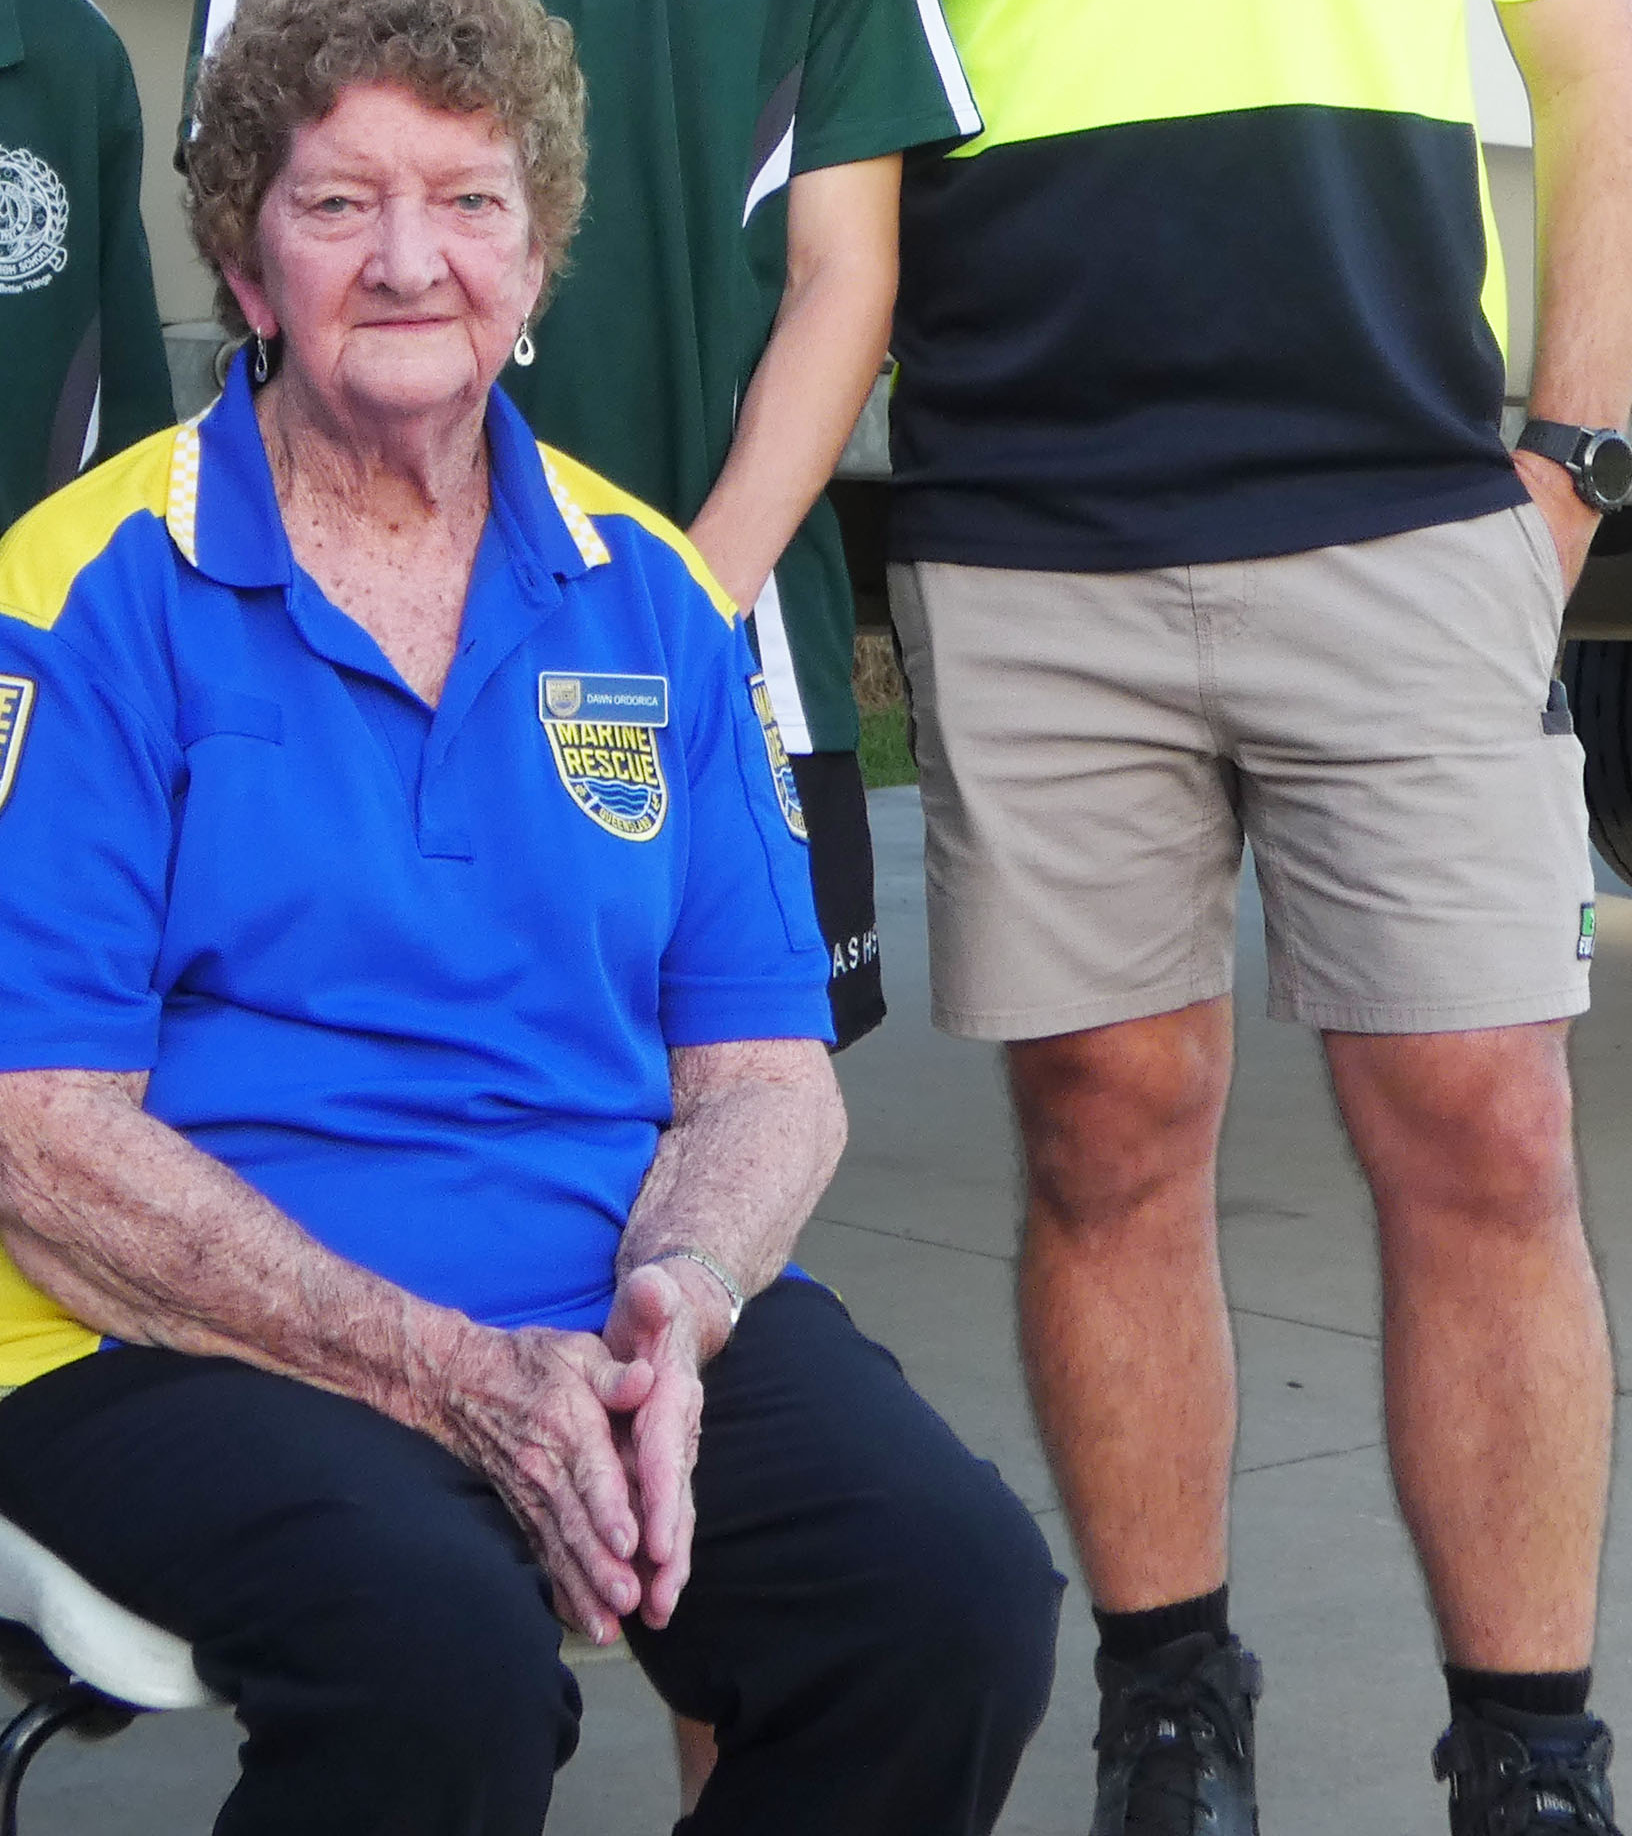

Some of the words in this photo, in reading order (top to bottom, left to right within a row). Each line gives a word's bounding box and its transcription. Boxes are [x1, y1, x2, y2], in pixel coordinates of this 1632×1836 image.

[18, 244, 54, 273] SCHOOL
[586, 693, 614, 705] DAWN
[555, 723, 652, 753] MARINE
[563, 746, 659, 786] RESCUE
